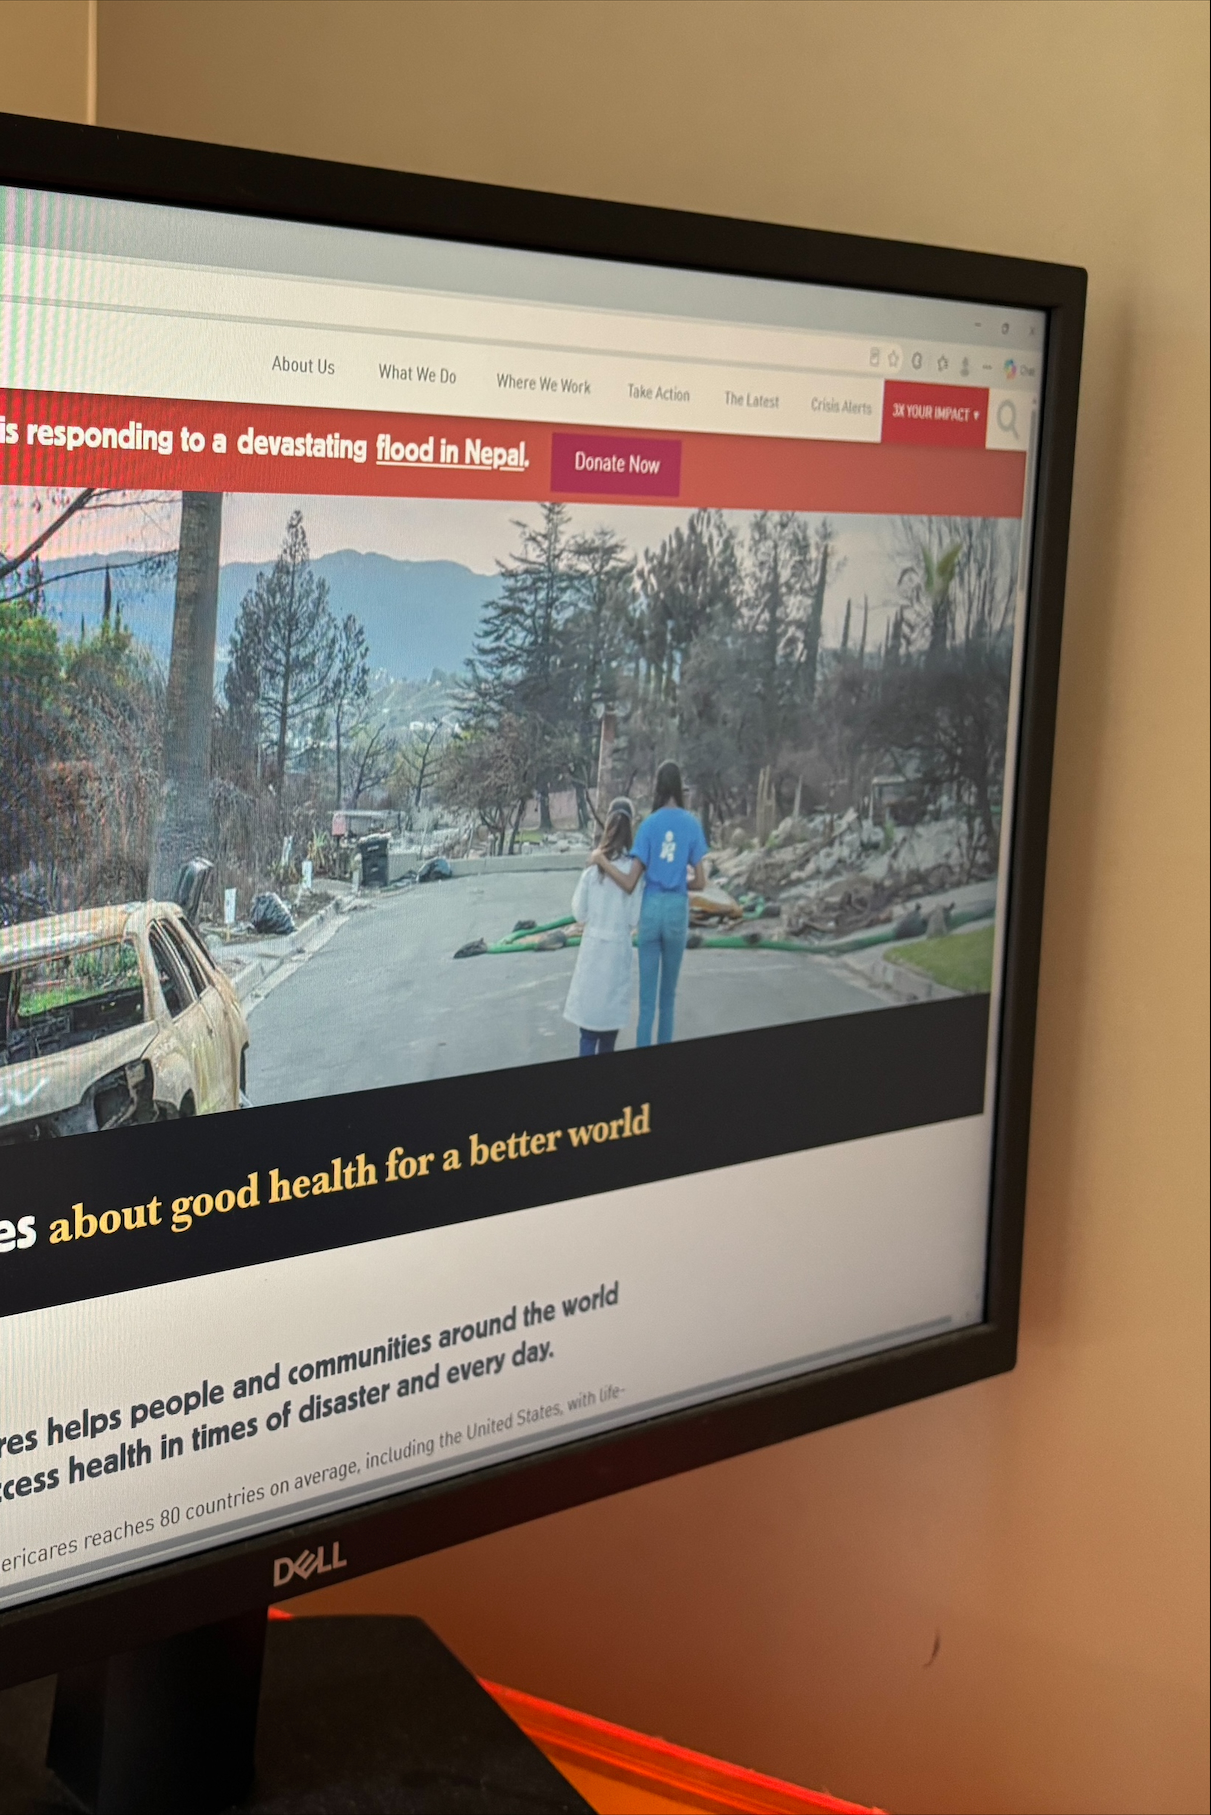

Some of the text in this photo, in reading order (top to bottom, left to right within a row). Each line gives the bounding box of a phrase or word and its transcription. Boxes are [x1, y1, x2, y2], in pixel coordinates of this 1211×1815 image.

[272, 355, 335, 375] About Us
[378, 363, 457, 385] What We Do
[496, 372, 591, 395] Where We Work
[628, 383, 690, 402] Take Action
[725, 390, 779, 409] The Latest
[811, 397, 872, 416] Crisis Alerts
[892, 402, 970, 423] 3X YOUR IMPACT
[27, 420, 174, 455] responding
[180, 426, 206, 453] to
[212, 432, 227, 454] a
[237, 426, 368, 464] devastating
[376, 433, 434, 463] flood
[439, 438, 459, 464] in
[464, 439, 530, 470] Nepal.
[574, 451, 661, 476] Donate Now
[48, 1195, 163, 1245] about
[170, 1171, 261, 1233] good
[268, 1152, 378, 1205] health
[385, 1146, 435, 1183] for
[442, 1148, 461, 1172] a
[468, 1129, 562, 1167] better
[567, 1102, 652, 1147] world
[46, 1407, 122, 1446] helps
[130, 1379, 225, 1429] people
[232, 1362, 281, 1399] and
[288, 1333, 432, 1386] communities
[438, 1305, 517, 1349] around
[523, 1300, 557, 1327] the
[562, 1280, 620, 1318] world
[68, 1437, 152, 1485] health
[160, 1434, 184, 1461] in
[191, 1416, 259, 1452] times
[265, 1398, 292, 1433] of
[298, 1380, 391, 1424] disaster
[396, 1362, 441, 1398] and
[446, 1353, 505, 1385] every
[511, 1339, 555, 1368] day.
[83, 1518, 155, 1550] reaches
[160, 1506, 180, 1528] 80
[185, 1485, 266, 1520] countries
[270, 1479, 290, 1497] on
[293, 1460, 361, 1492] average,
[365, 1438, 435, 1470] including
[439, 1429, 463, 1449] the
[466, 1413, 514, 1441] United
[516, 1400, 564, 1426] States,
[566, 1391, 597, 1414] with
[599, 1384, 626, 1403] life-
[273, 1539, 348, 1588] DELL
